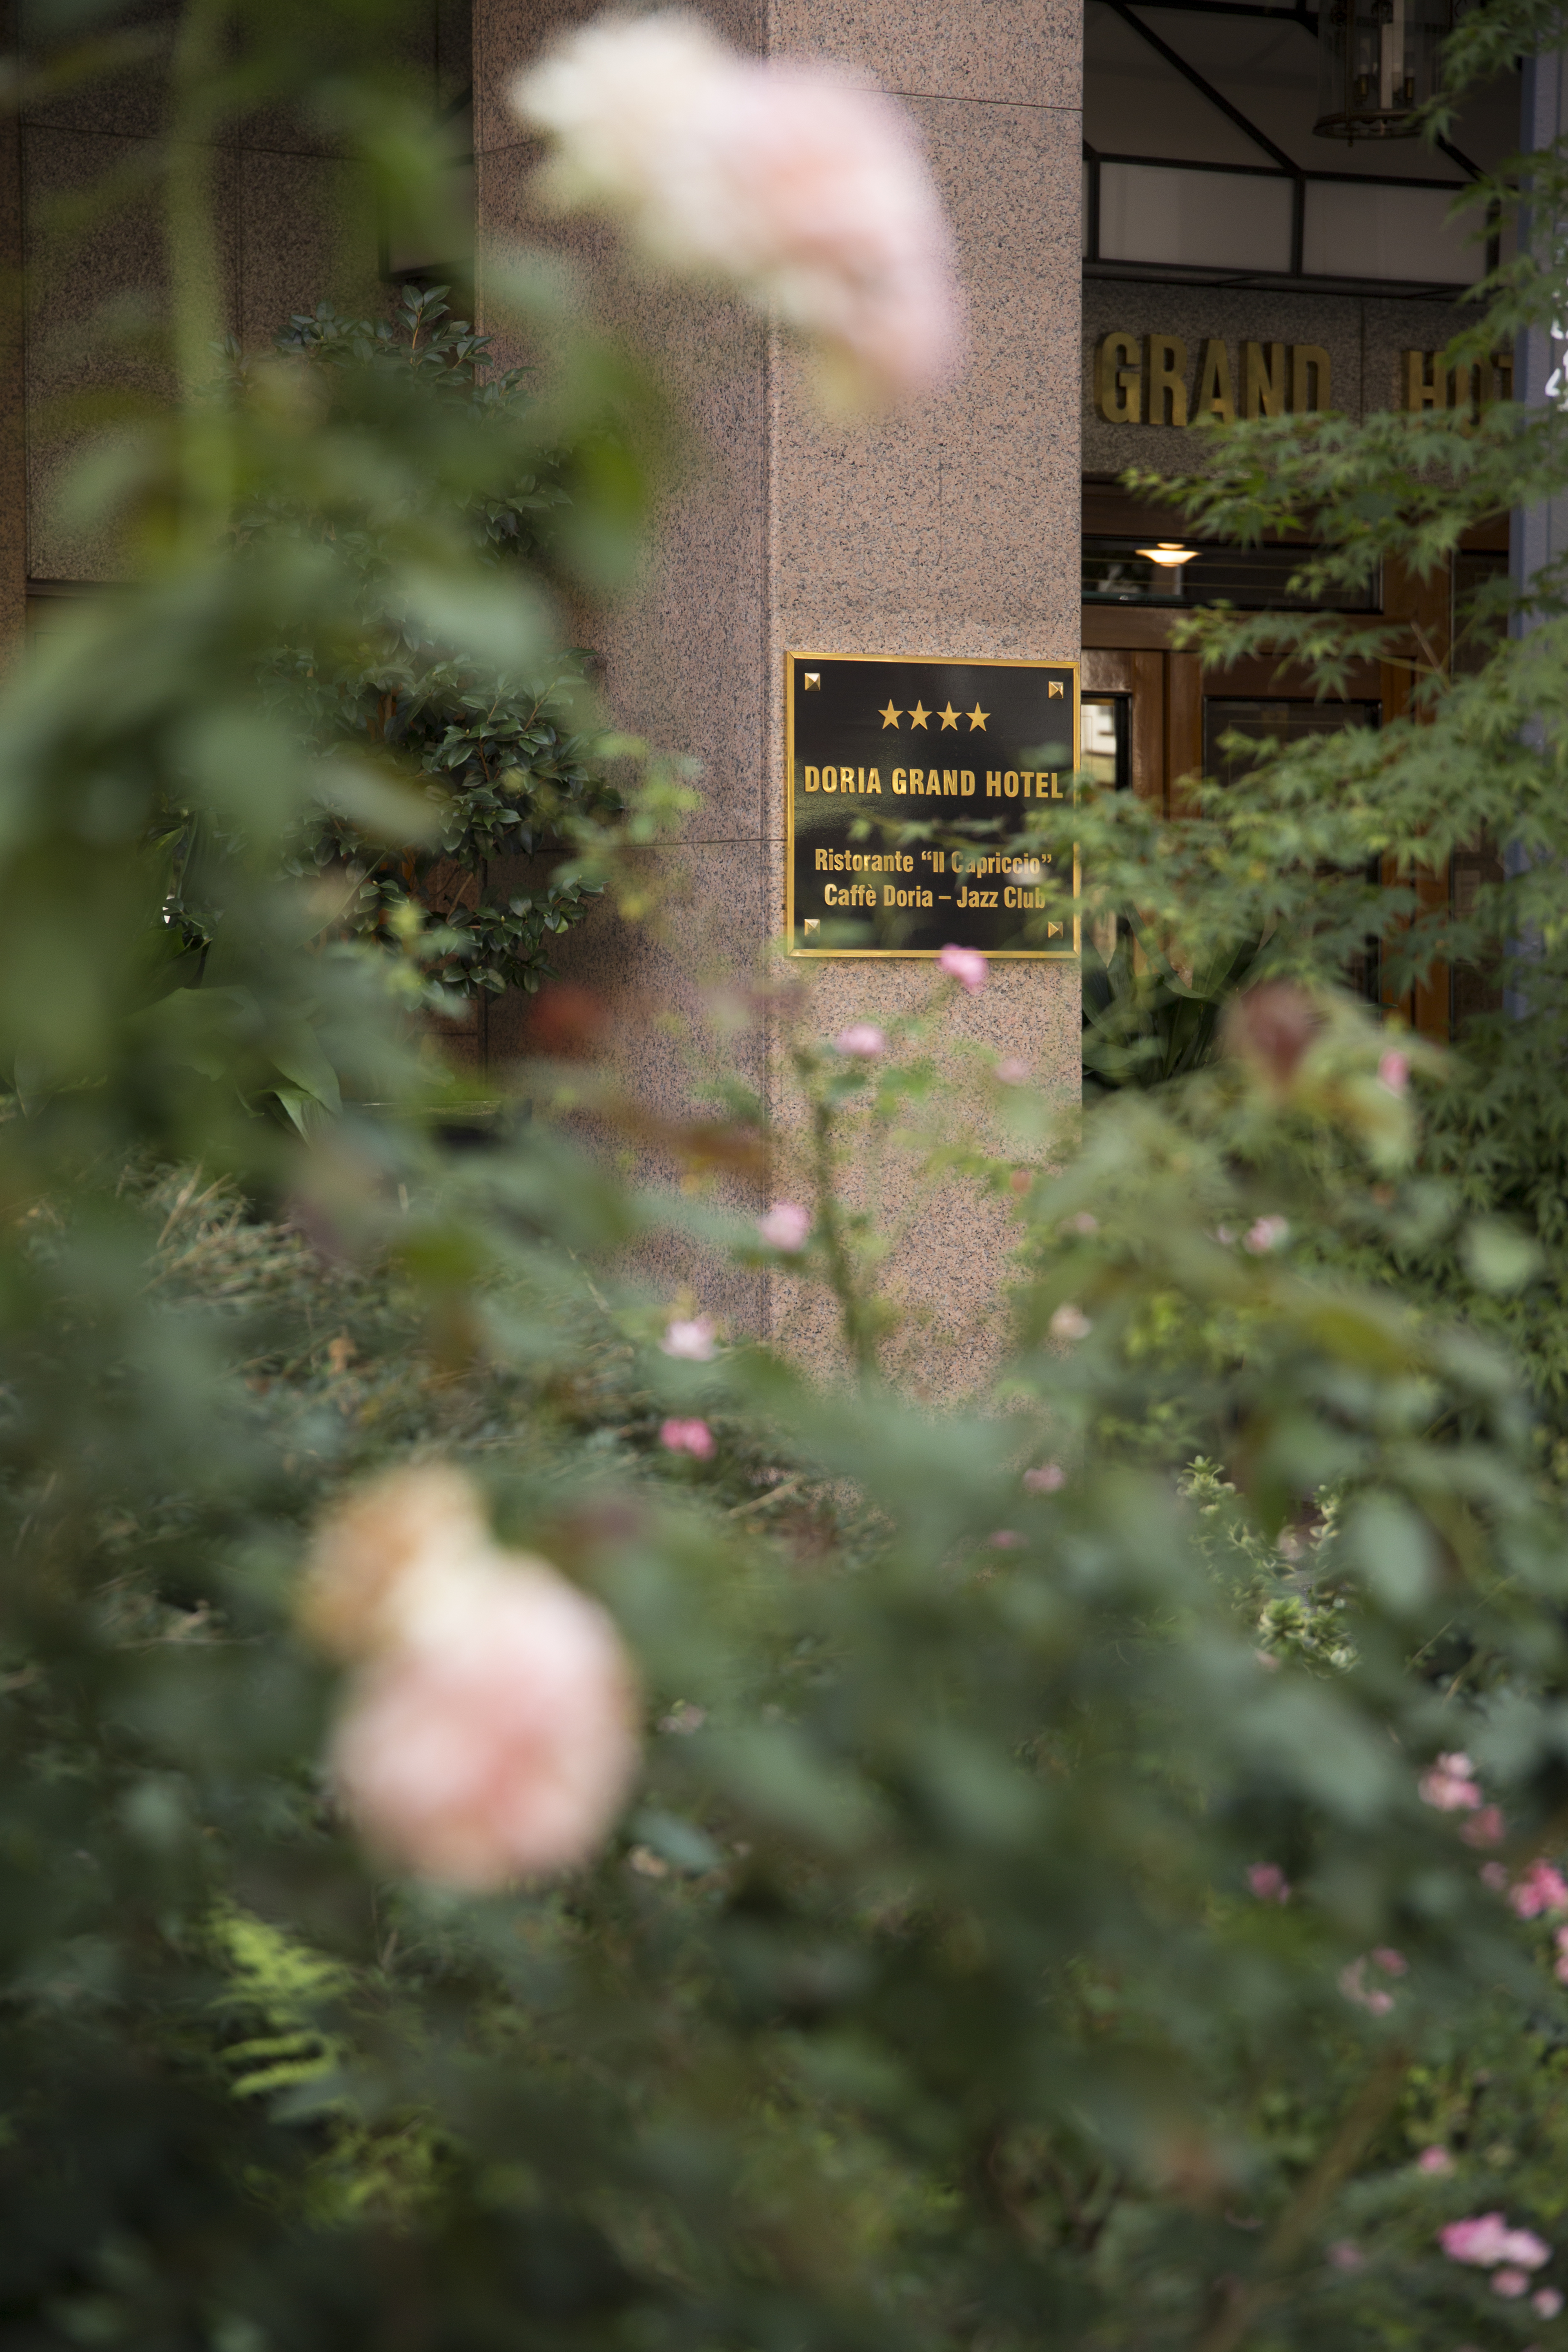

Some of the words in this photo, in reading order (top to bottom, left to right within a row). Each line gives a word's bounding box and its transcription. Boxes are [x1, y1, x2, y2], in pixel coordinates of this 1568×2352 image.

[1095, 331, 1331, 426] GRAND
[804, 766, 882, 794] DORIA
[891, 768, 976, 797] GRAND
[986, 771, 1064, 798] HOTEL
[815, 849, 913, 872] Ristorante
[951, 852, 1052, 878] Capriccio”
[824, 883, 876, 906] Caffè
[883, 884, 933, 908] Doria
[957, 886, 998, 908] Jazz
[1003, 886, 1045, 909] Club
